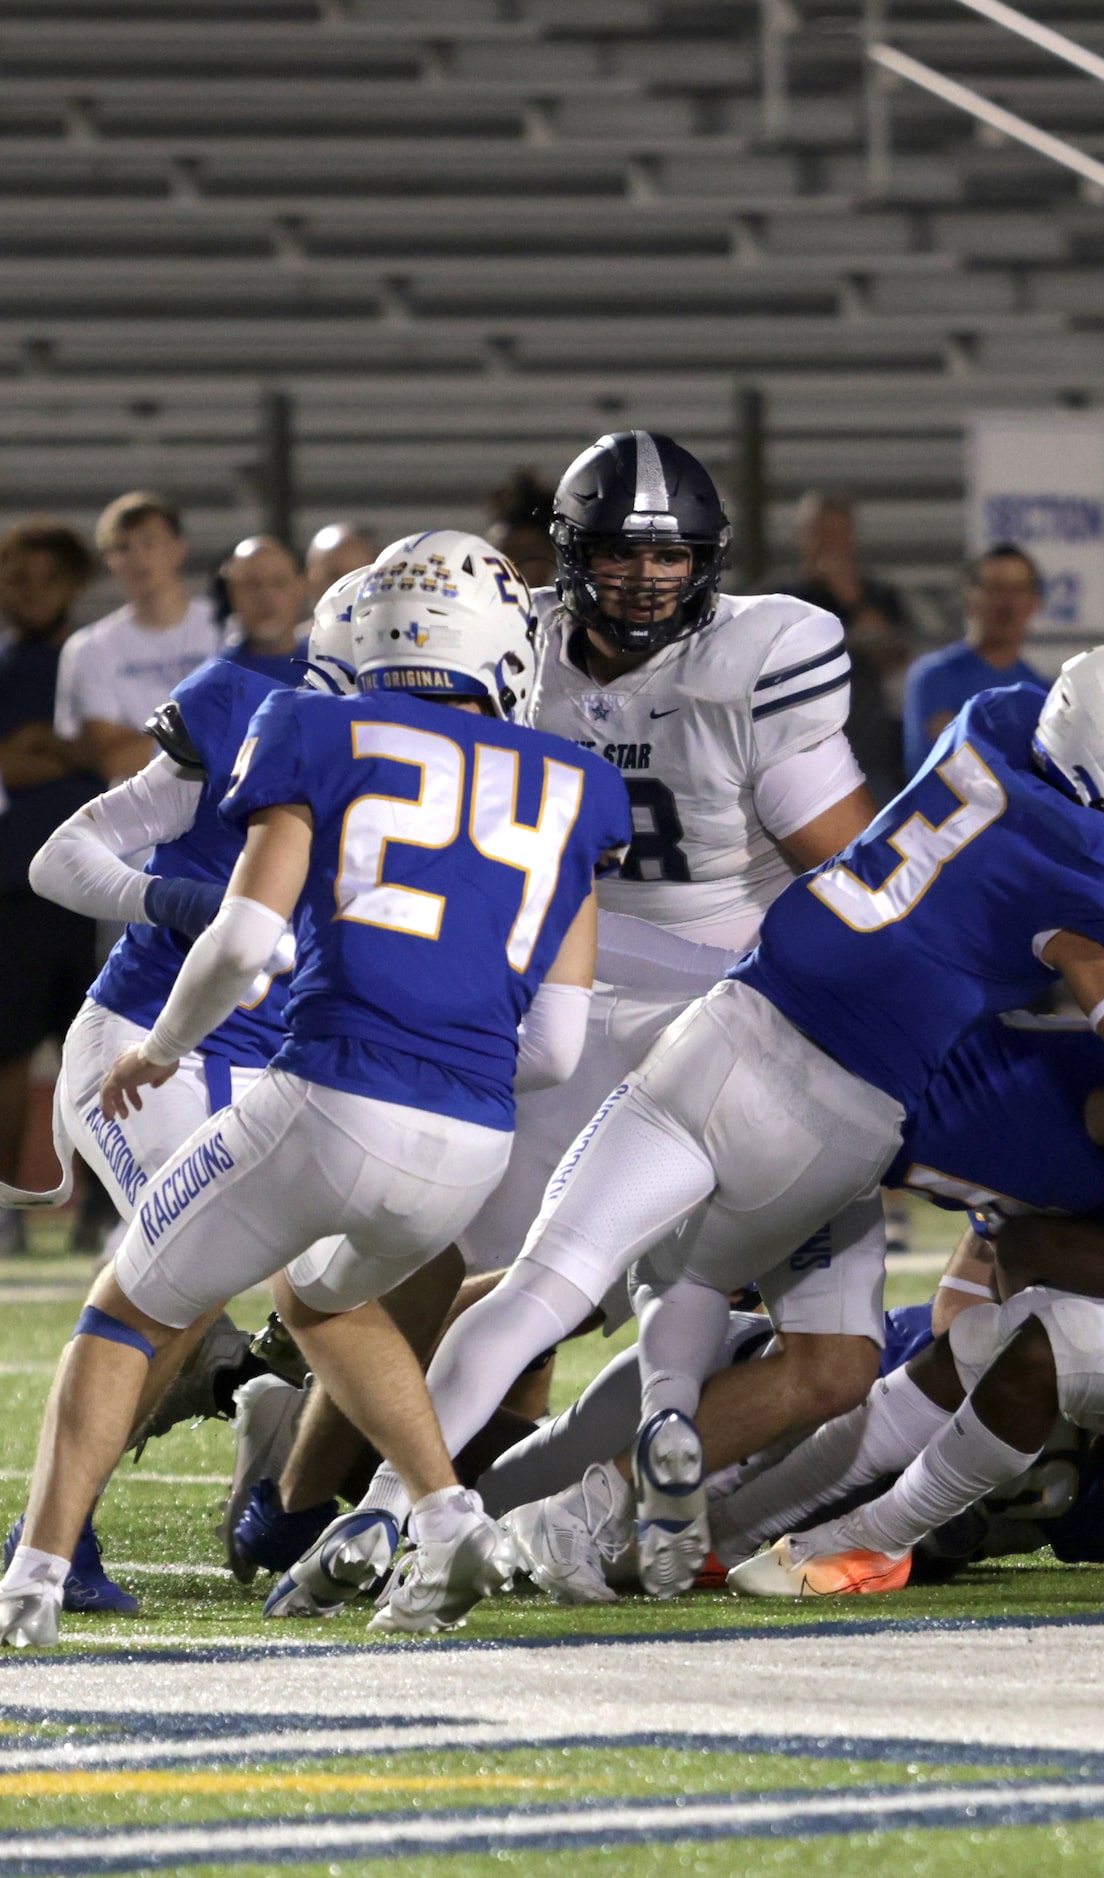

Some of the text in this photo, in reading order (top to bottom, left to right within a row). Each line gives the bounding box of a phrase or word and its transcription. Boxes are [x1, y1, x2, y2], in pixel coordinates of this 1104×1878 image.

[360, 670, 454, 690] THE ORIGINAL
[603, 743, 651, 769] STAR
[332, 720, 585, 975] 24
[806, 742, 1008, 933] 3
[140, 1132, 235, 1246] RACCOONS
